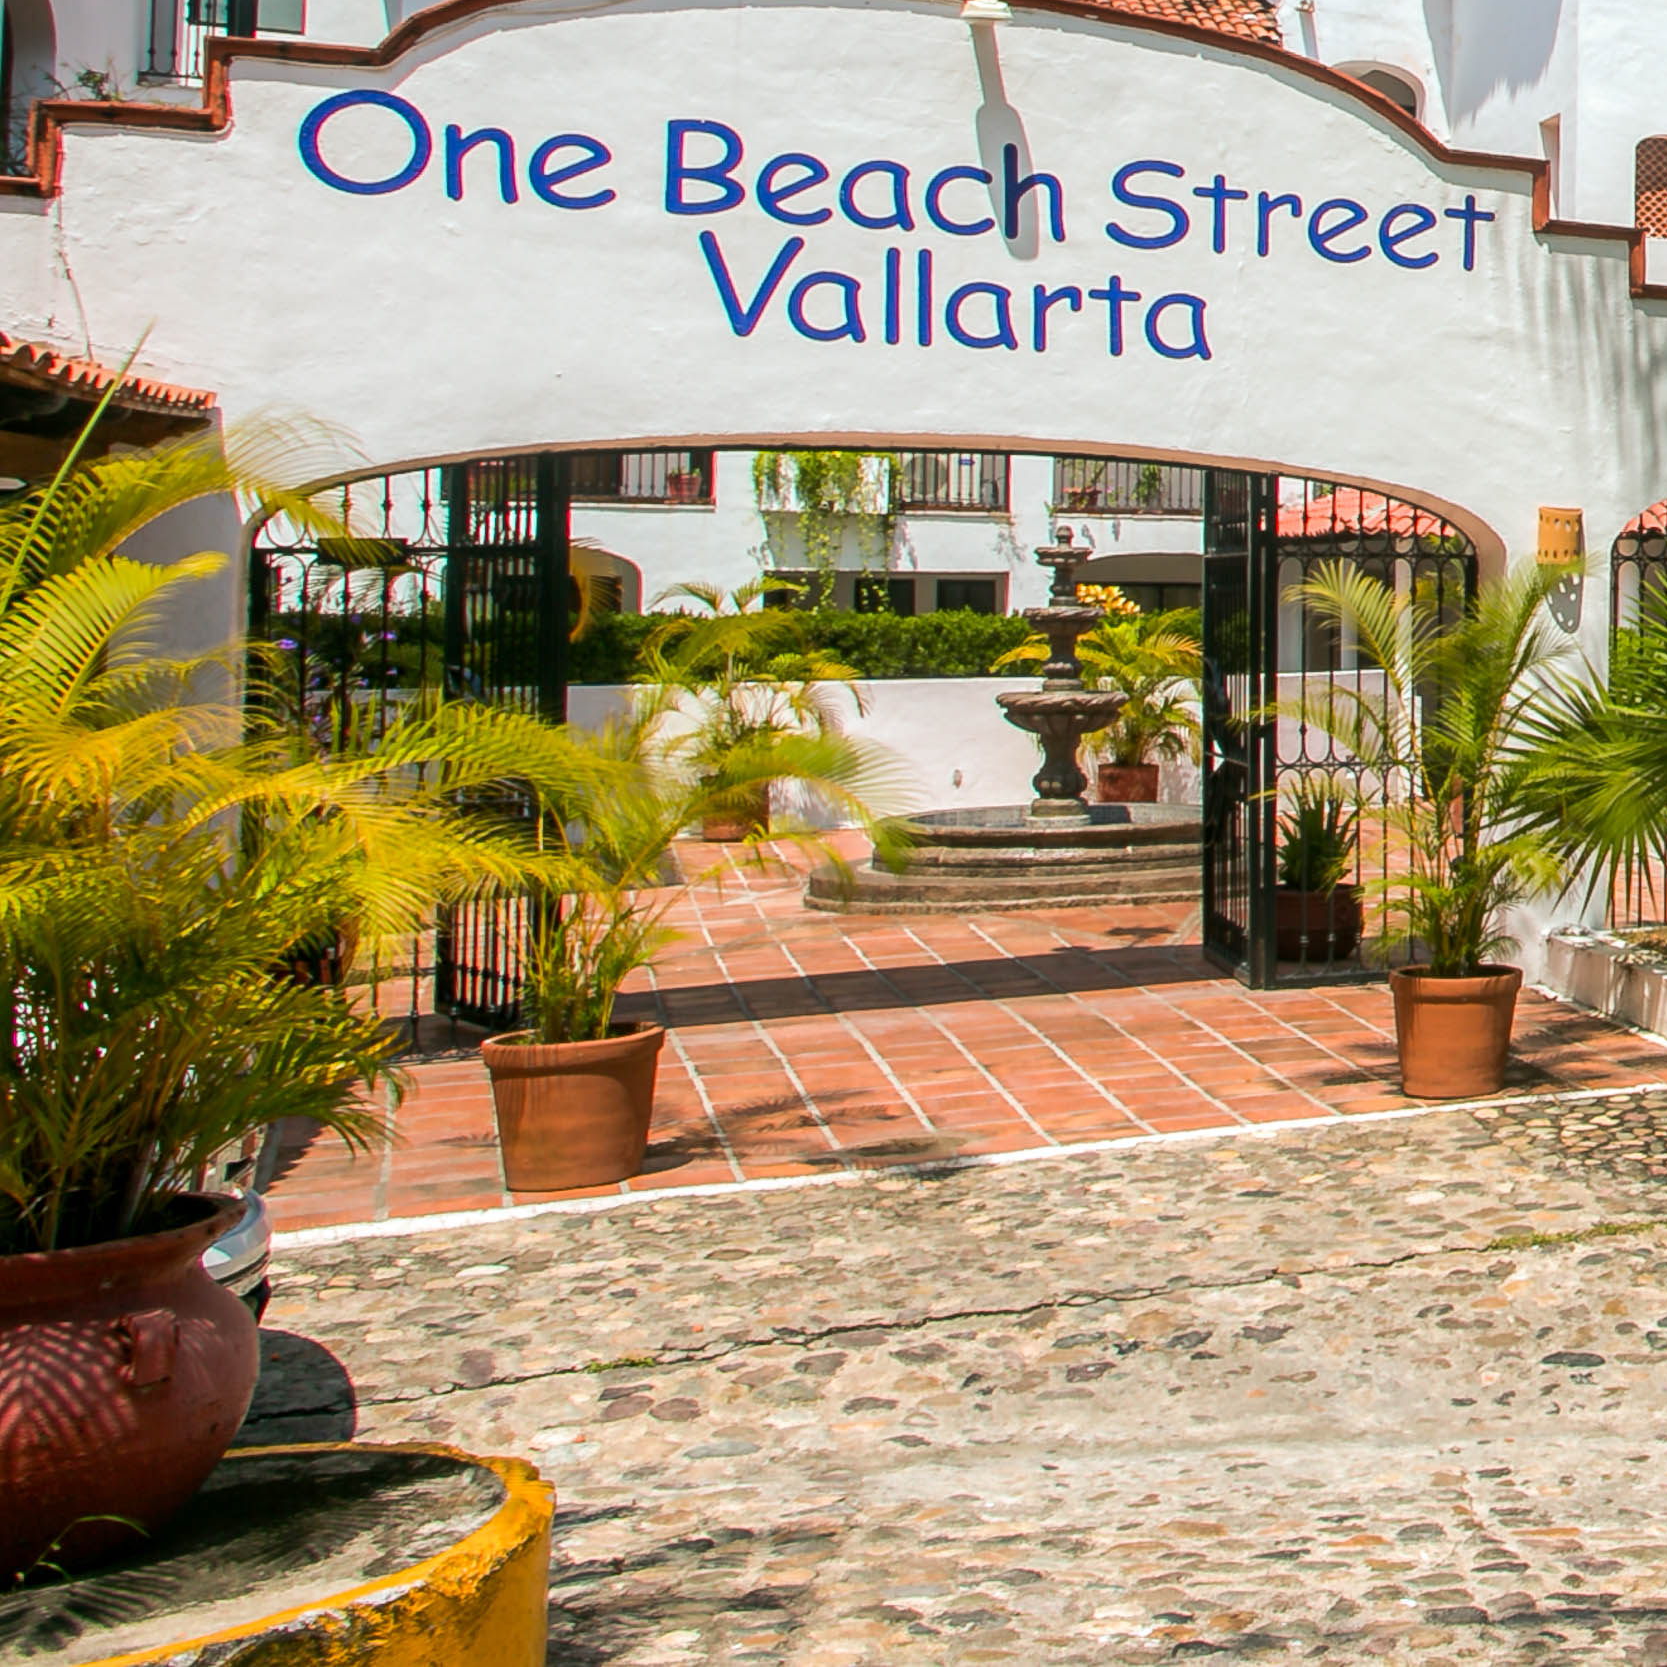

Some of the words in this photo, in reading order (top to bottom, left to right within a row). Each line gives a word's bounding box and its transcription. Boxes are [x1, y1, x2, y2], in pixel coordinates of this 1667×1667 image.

[298, 89, 616, 209] One
[664, 119, 1066, 242] Beach
[1103, 159, 1496, 273] Street
[699, 230, 1212, 361] Vallarta
